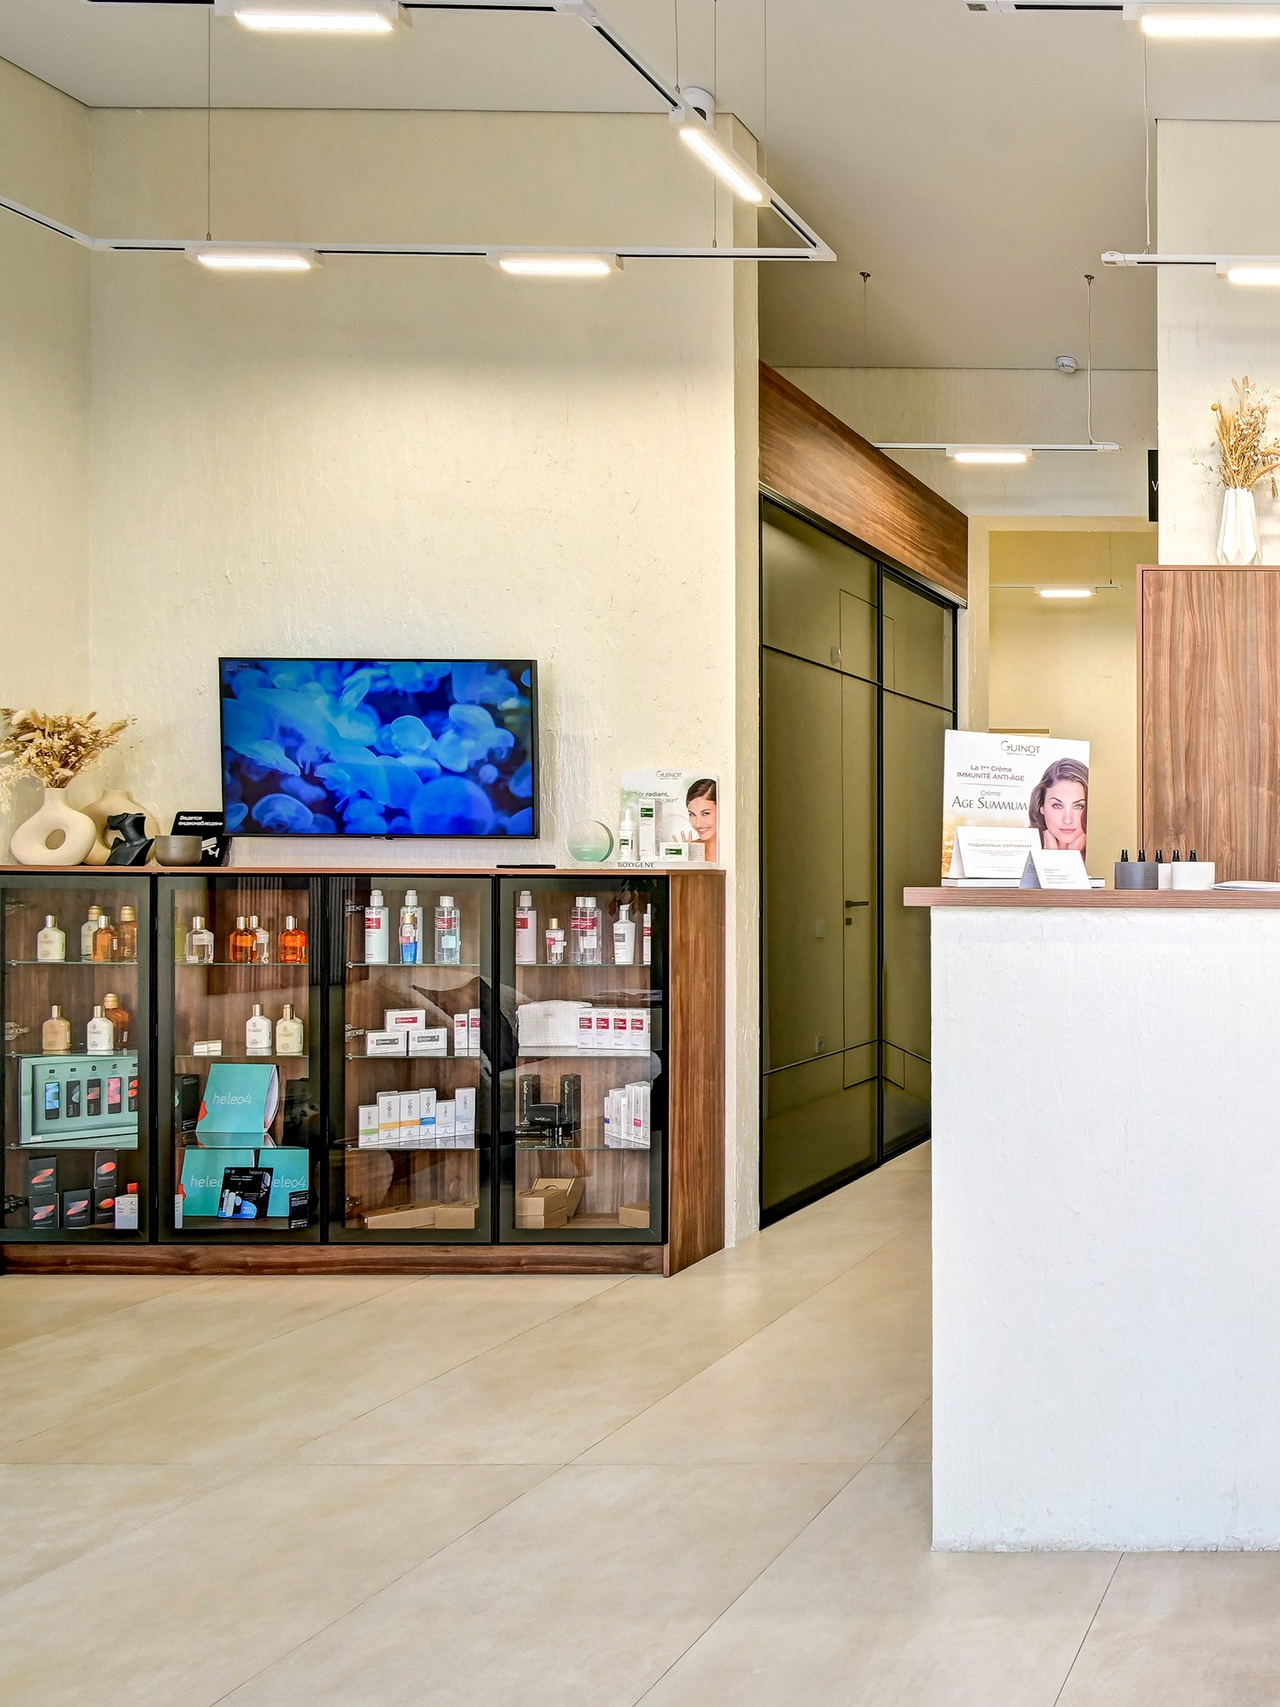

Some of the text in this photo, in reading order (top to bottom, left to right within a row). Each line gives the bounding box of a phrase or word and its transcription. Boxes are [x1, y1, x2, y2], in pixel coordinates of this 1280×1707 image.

[1000, 740, 1041, 754] GUINOT
[656, 770, 682, 778] GUINOT
[991, 765, 1013, 773] Crème
[956, 771, 1025, 782] IMMUNITÉ ANTI-ÂGE
[980, 789, 1001, 797] Crème
[951, 795, 1028, 811] AGE SUMMUM
[212, 1091, 252, 1105] heleo4
[273, 1176, 307, 1188] eleo4
